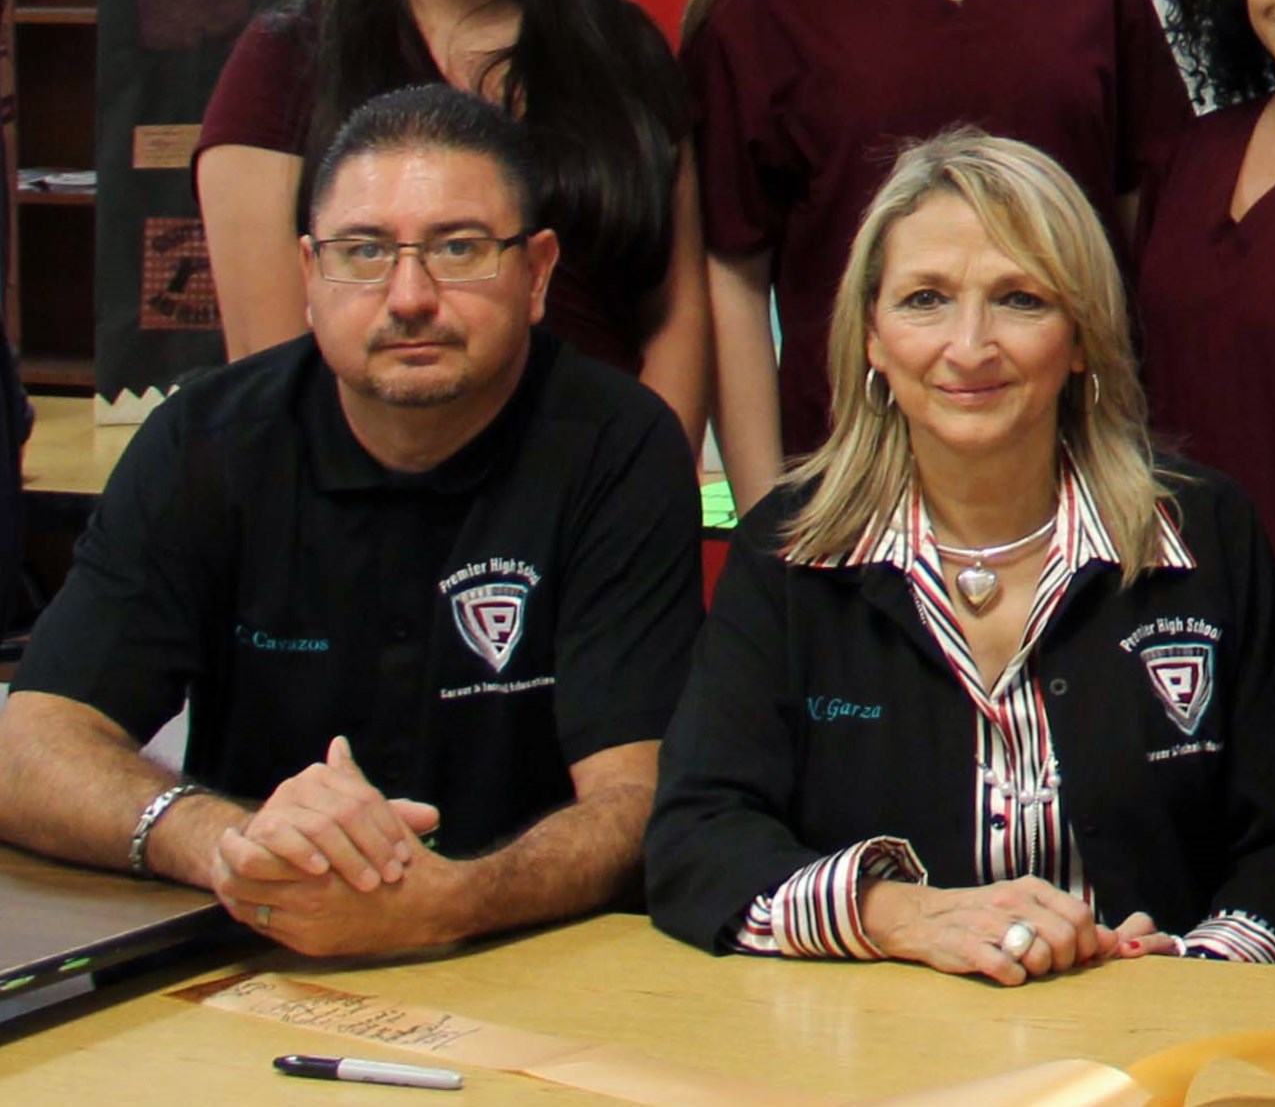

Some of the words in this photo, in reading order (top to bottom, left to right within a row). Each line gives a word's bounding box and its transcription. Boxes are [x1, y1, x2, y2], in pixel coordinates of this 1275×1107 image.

[438, 562, 487, 594] Premier
[490, 557, 516, 575] High
[1156, 617, 1184, 635] High
[1186, 617, 1222, 641] School
[827, 698, 882, 721] Garza
